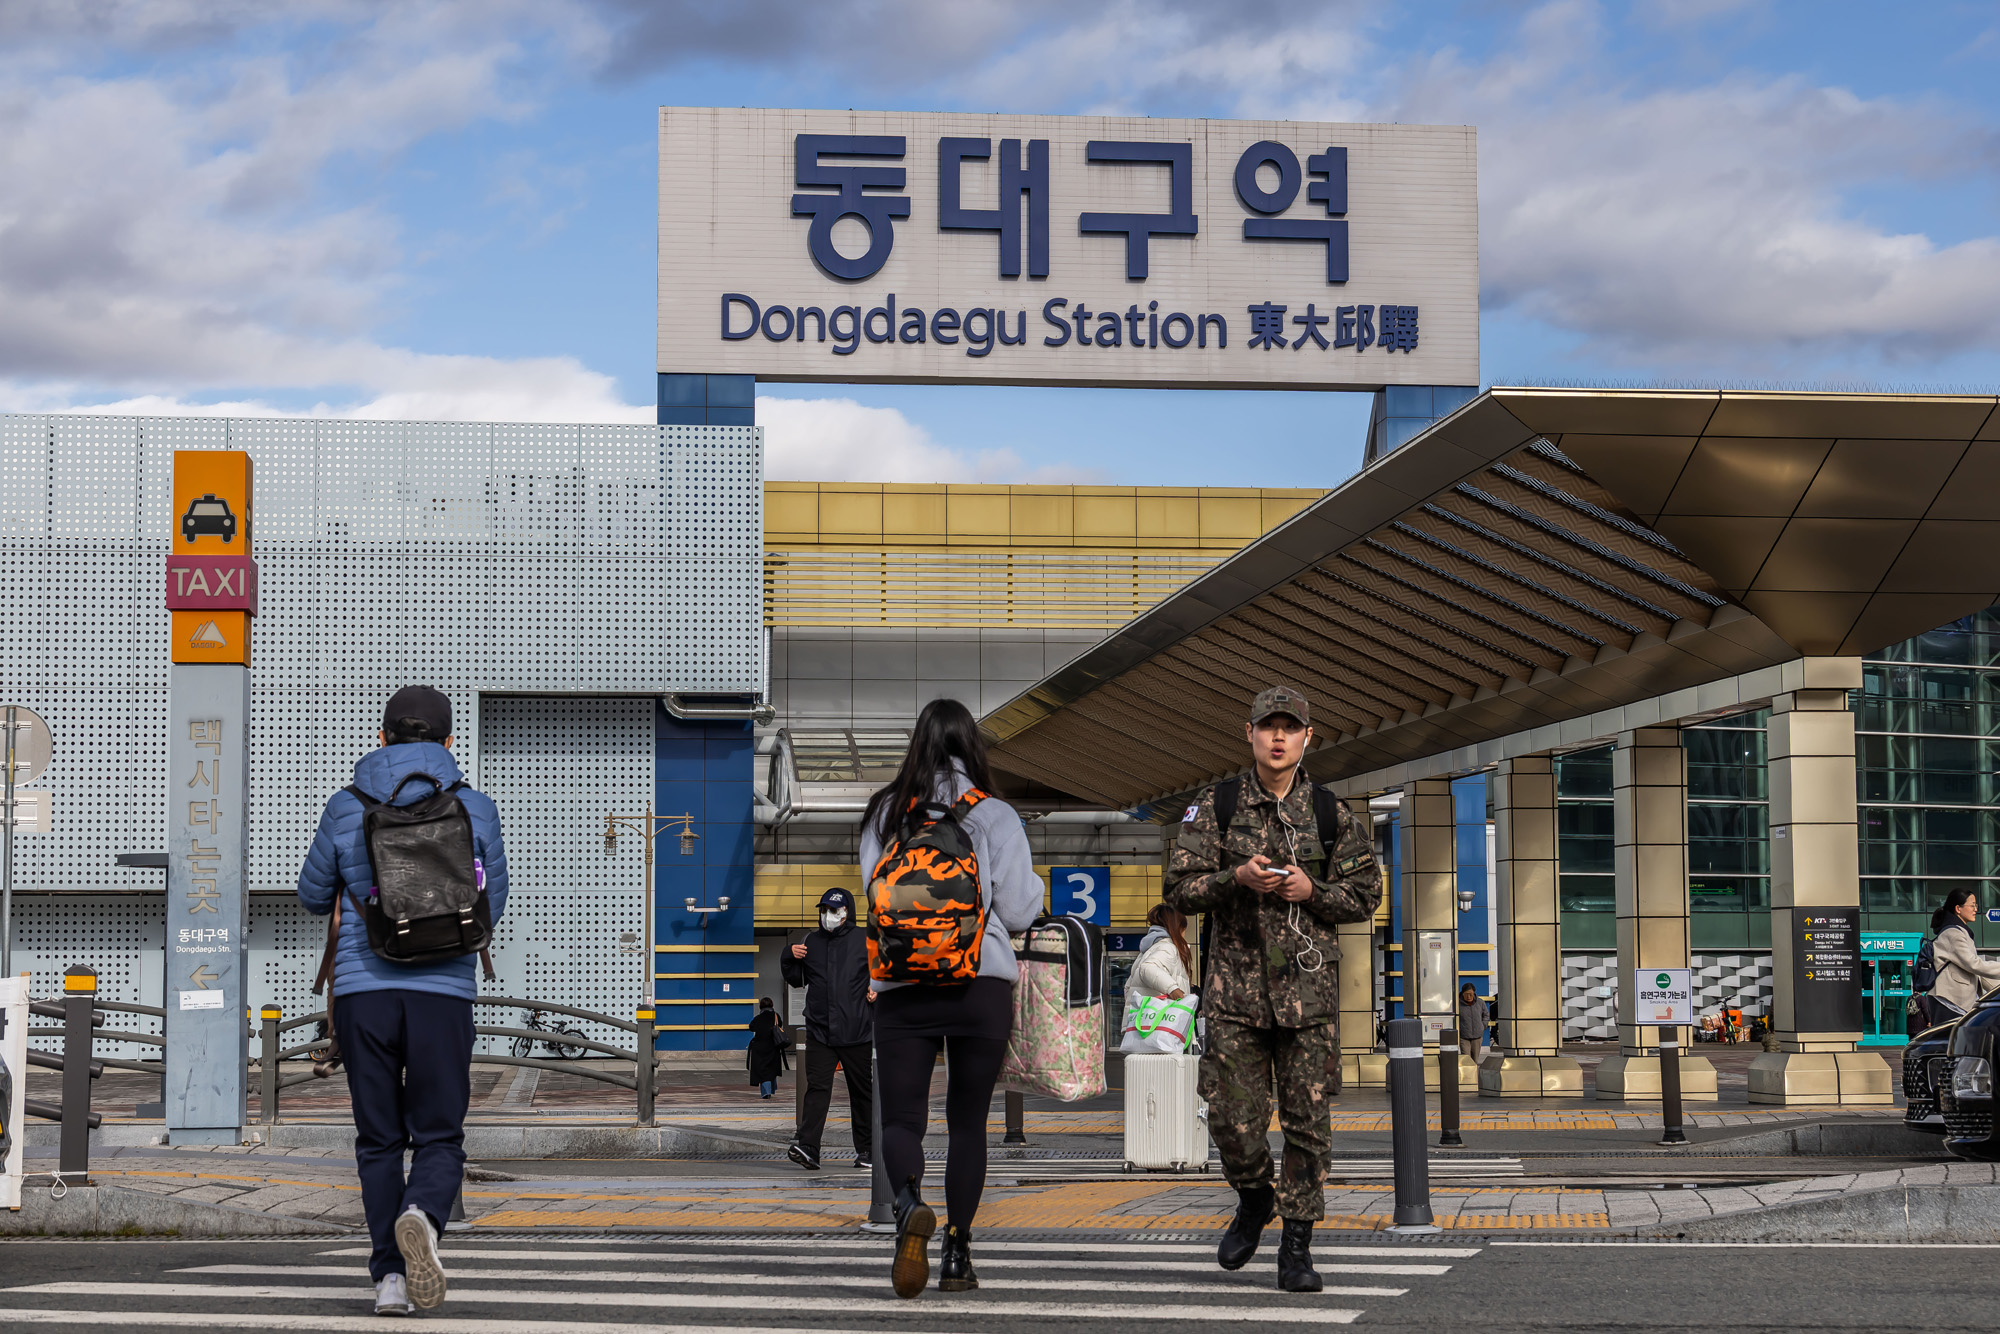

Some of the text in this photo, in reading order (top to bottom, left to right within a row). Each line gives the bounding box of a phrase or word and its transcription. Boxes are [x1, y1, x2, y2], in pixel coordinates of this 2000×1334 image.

[792, 133, 1349, 284] 동대구역
[721, 293, 1229, 356] Dongdaegu Station
[1246, 301, 1420, 353] 東大邱驛
[171, 568, 245, 597] TAXI
[1066, 872, 1097, 920] 3
[178, 928, 228, 942] 동대구역
[1115, 936, 1124, 949] 3
[1873, 940, 1904, 949] iM뱅크
[176, 945, 217, 954] Dongdaegu
[218, 945, 232, 953] Stn.
[1640, 991, 1687, 999] 흡연구역 가는길
